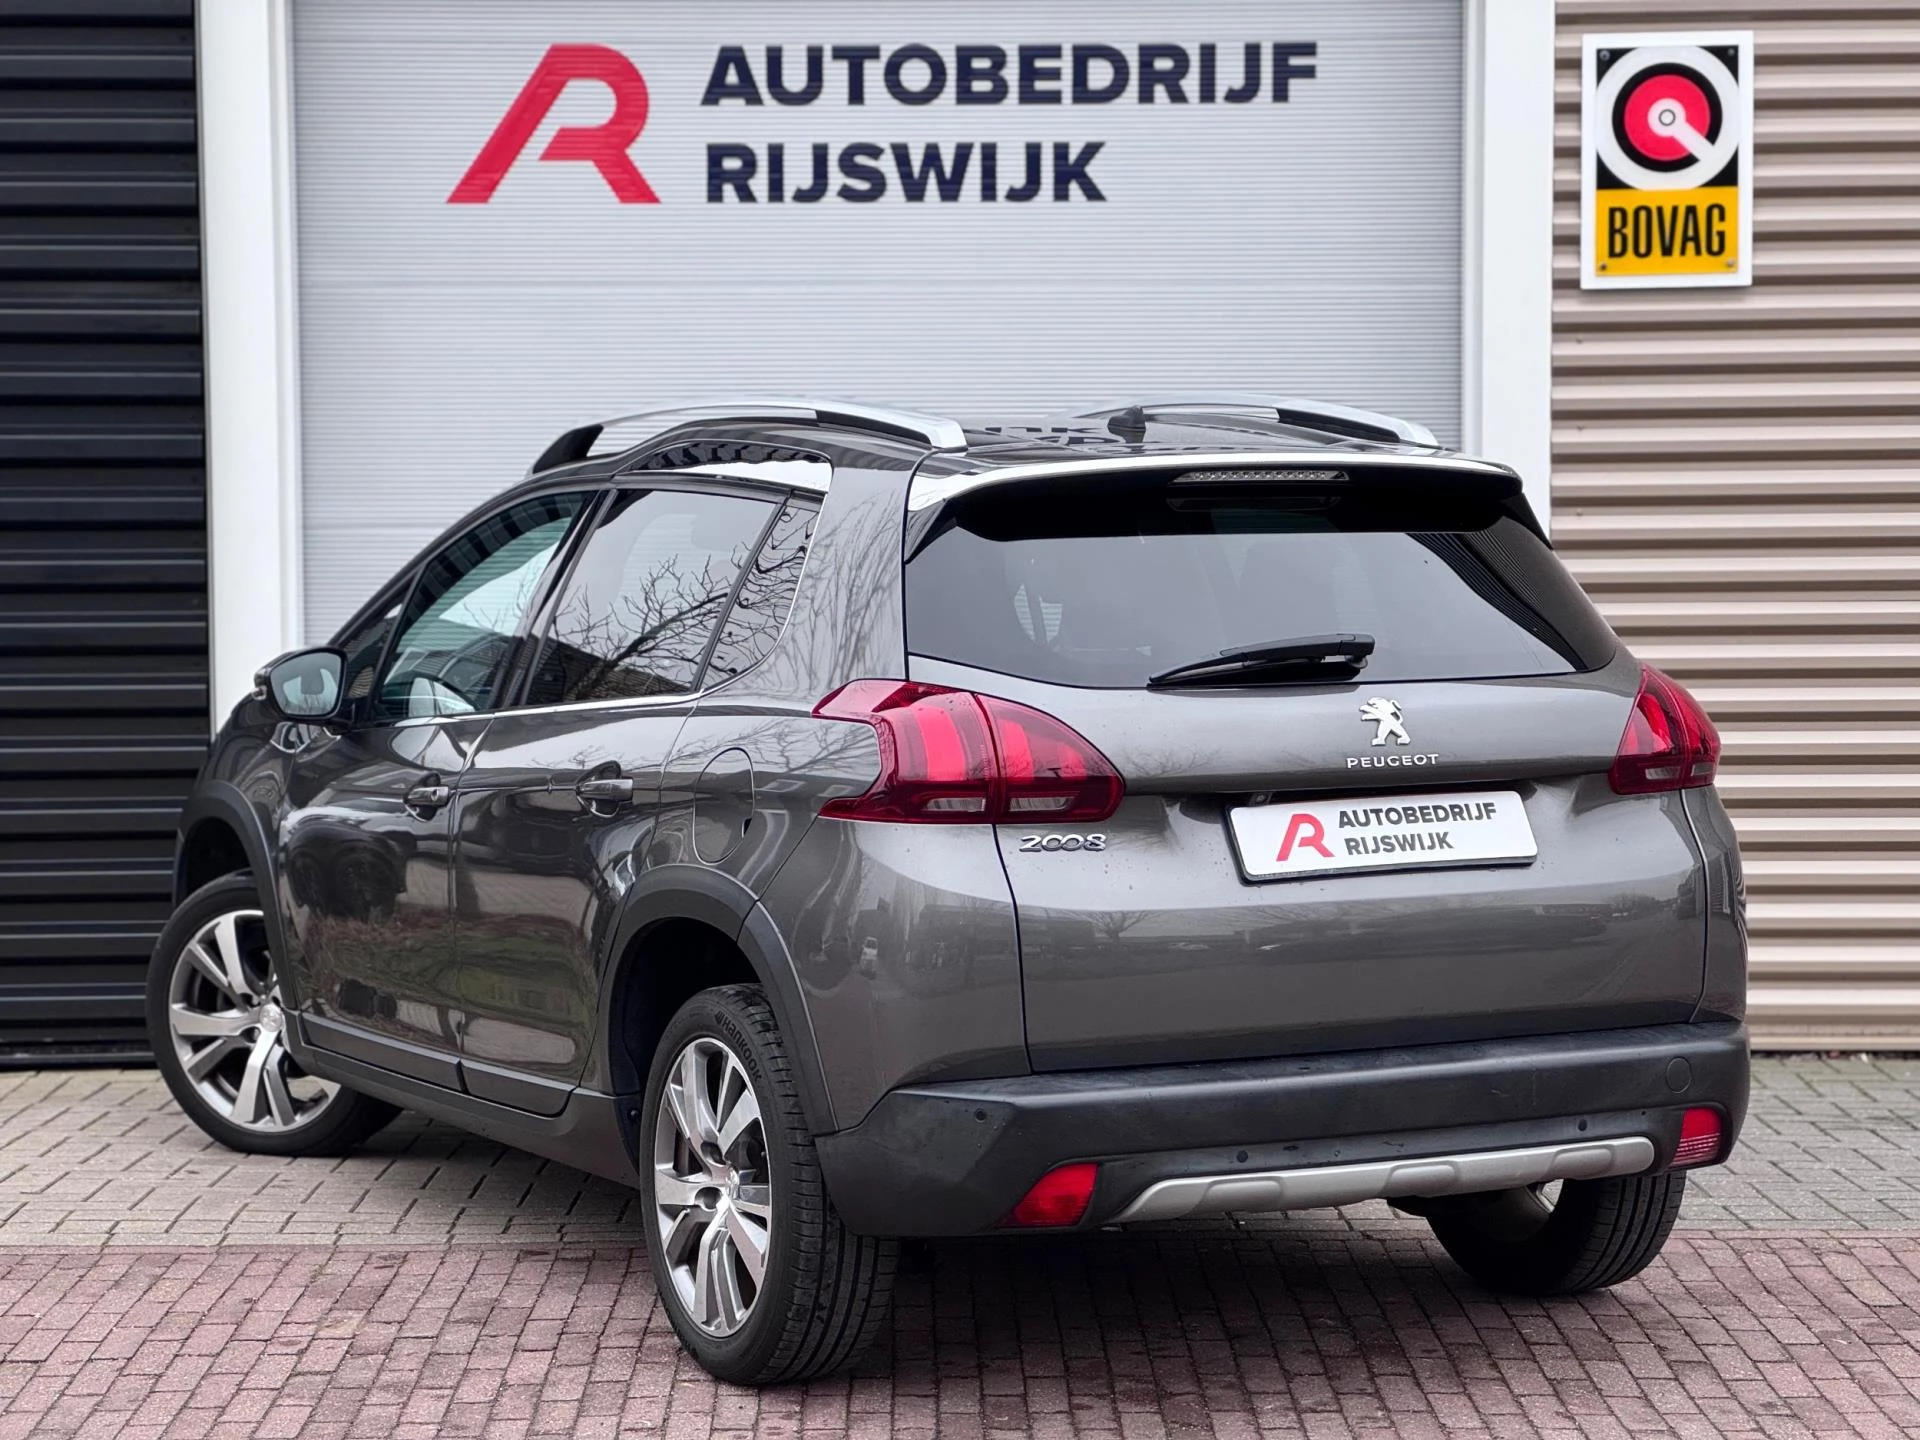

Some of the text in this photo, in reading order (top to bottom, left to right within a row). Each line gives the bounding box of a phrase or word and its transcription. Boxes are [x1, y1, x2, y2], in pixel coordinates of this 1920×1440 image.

[700, 43, 1317, 106] AUTOBEDRIJF
[707, 142, 1107, 203] RIJSWIJK
[1608, 203, 1725, 258] BOVAG
[1346, 753, 1439, 768] PEUGEOT
[1338, 802, 1497, 829] AUTOBEDRIJF
[1019, 834, 1107, 852] 2008
[1344, 831, 1454, 856] RIJSWIJK
